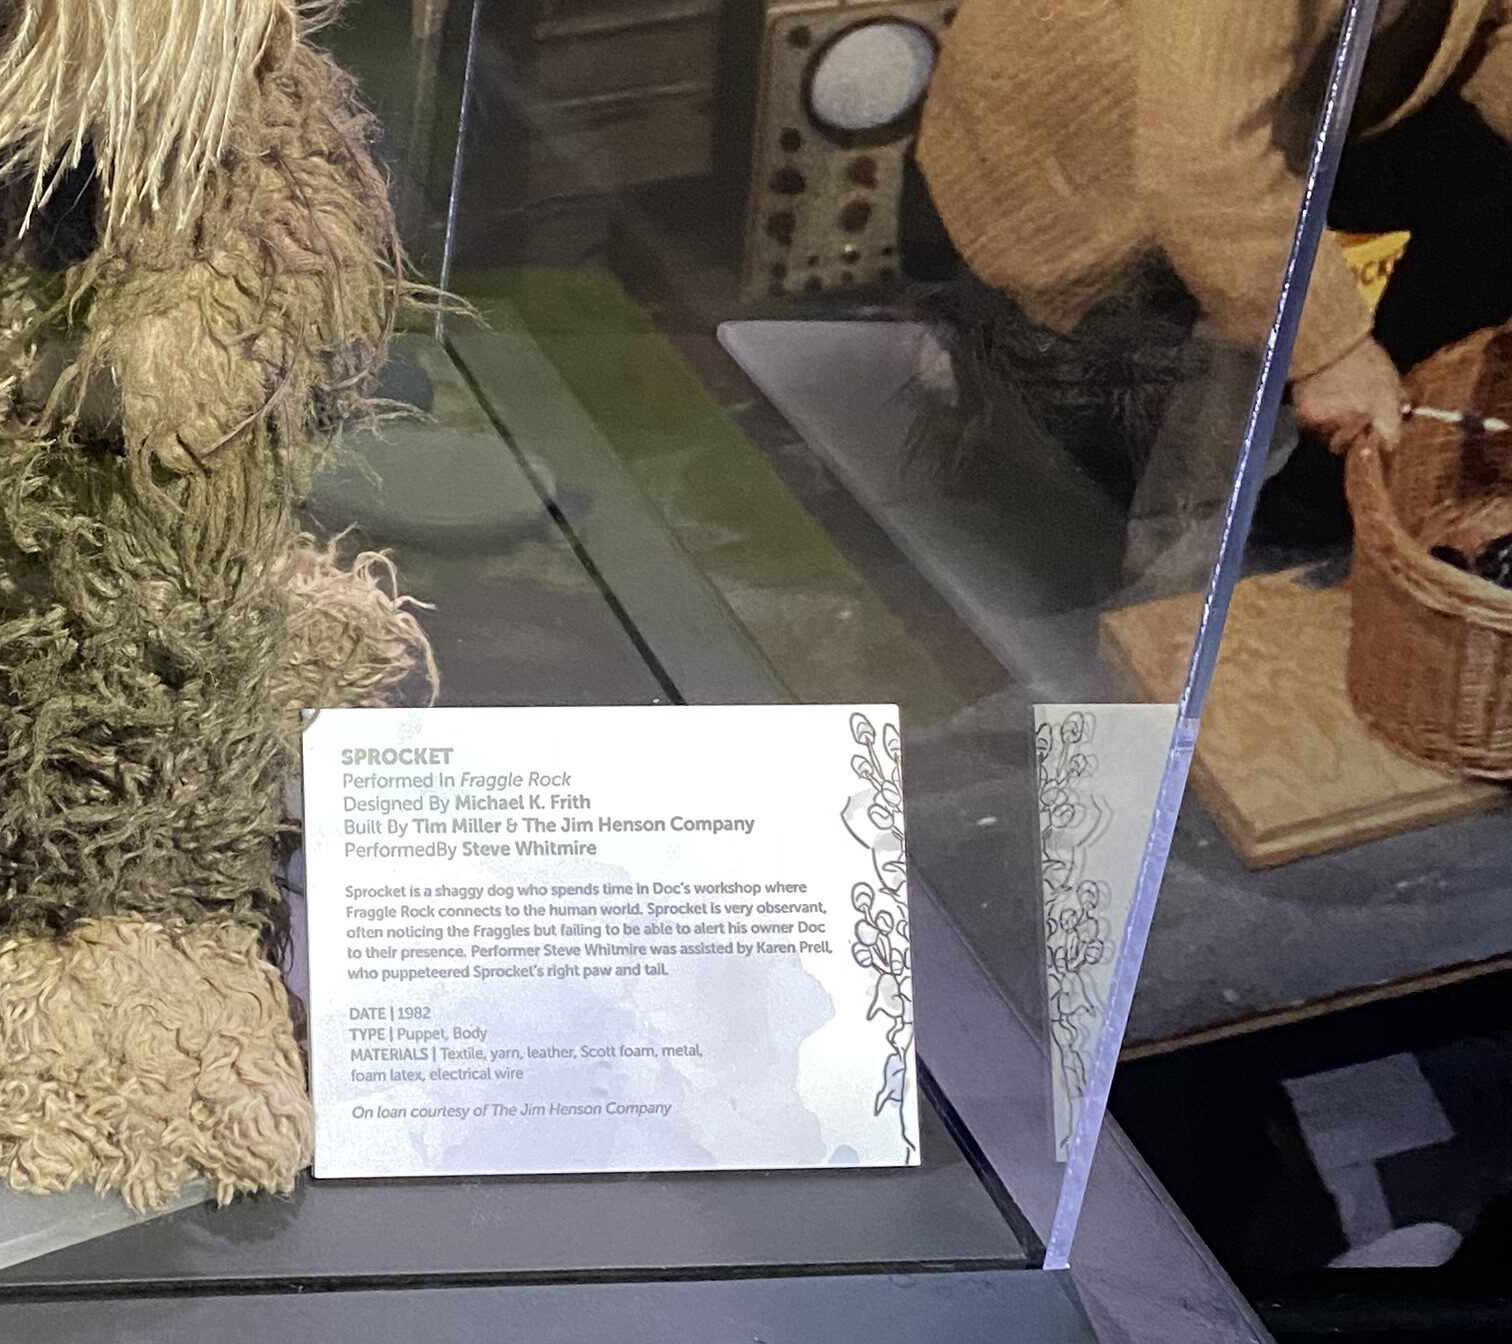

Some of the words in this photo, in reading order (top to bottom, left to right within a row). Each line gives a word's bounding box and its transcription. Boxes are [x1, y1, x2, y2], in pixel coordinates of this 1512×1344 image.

[341, 748, 454, 765] SPROCKET
[343, 773, 433, 788] Performed
[439, 773, 455, 787] In
[460, 772, 523, 791] Fraggle
[527, 772, 571, 786] Rock
[343, 796, 423, 815] Designed
[428, 796, 450, 814] By
[454, 795, 525, 810] Michael
[528, 795, 545, 809] K.
[550, 795, 590, 809] Frith
[344, 819, 382, 834] Built
[387, 819, 408, 838] By
[411, 819, 447, 833] Tim
[451, 818, 502, 833] Miller
[505, 818, 518, 833] &
[521, 818, 556, 832] The
[560, 817, 593, 832] Jim
[598, 817, 665, 831] Henson
[669, 816, 755, 834] Company
[344, 842, 457, 860] PerformedBy
[461, 841, 511, 856] Steve
[514, 840, 597, 856] Whitmire
[345, 886, 406, 900] Sprocket
[409, 886, 421, 897] is
[423, 887, 432, 896] a
[434, 885, 484, 899] shaggy
[486, 884, 514, 899] dog
[516, 884, 548, 896] who
[550, 883, 599, 898] spends
[601, 883, 633, 895] time
[635, 883, 649, 894] in
[693, 882, 761, 896] workshop
[764, 881, 807, 893] where
[346, 906, 397, 921] Fraggle
[400, 905, 435, 917] Rock
[437, 906, 502, 917] connects
[504, 905, 520, 916] to
[522, 904, 546, 916] the
[548, 904, 597, 916] human
[599, 903, 643, 915] world.
[646, 902, 708, 917] Sprocket
[710, 902, 722, 914] is
[723, 905, 754, 916] very
[756, 902, 827, 914] observant,
[346, 927, 383, 938] often
[386, 926, 443, 940] noticing
[446, 925, 470, 937] the
[473, 924, 530, 940] Fraggles
[533, 924, 557, 936] but
[560, 924, 602, 938] failing
[604, 924, 620, 935] to
[622, 923, 641, 935] be
[643, 923, 674, 935] able
[675, 923, 691, 934] to
[693, 922, 725, 934] alert
[727, 922, 748, 934] his
[750, 924, 794, 933] owner
[797, 921, 826, 933] Doc
[347, 948, 362, 958] to
[365, 946, 398, 958] their
[400, 948, 467, 960] presence.
[470, 945, 541, 957] Performer
[543, 944, 581, 956] Steve
[584, 943, 647, 956] Whitmire
[649, 946, 677, 955] was
[679, 942, 734, 954] assisted
[736, 942, 754, 956] by
[756, 942, 795, 953] Karen
[799, 941, 833, 954] Prell,
[347, 967, 379, 979] who
[381, 966, 470, 982] puppeteered
[546, 964, 581, 979] right
[582, 967, 613, 979] paw
[614, 963, 641, 976] and
[643, 963, 669, 975] tail.
[349, 1007, 387, 1020] DATE
[397, 1006, 431, 1019] 1982
[348, 1028, 386, 1040] TYPE
[396, 1028, 449, 1043] Puppet,
[452, 1027, 488, 1042] Body
[350, 1048, 429, 1061] MATERIALS
[438, 1047, 488, 1060] Textile,
[489, 1049, 525, 1062] yarn,
[526, 1046, 577, 1059] leather,
[580, 1045, 616, 1057] Scott
[618, 1045, 659, 1058] foam,
[660, 1044, 703, 1057] metal,
[350, 1068, 388, 1081] foam
[389, 1068, 426, 1082] latex,
[428, 1067, 492, 1080] electrical
[495, 1067, 524, 1080] wire
[351, 1106, 373, 1119] On
[376, 1105, 407, 1118] loan
[409, 1106, 470, 1120] courtesy
[472, 1104, 489, 1117] of
[489, 1104, 518, 1116] The
[519, 1103, 545, 1115] Jim
[548, 1102, 602, 1115] Henson
[605, 1102, 672, 1116] Company
